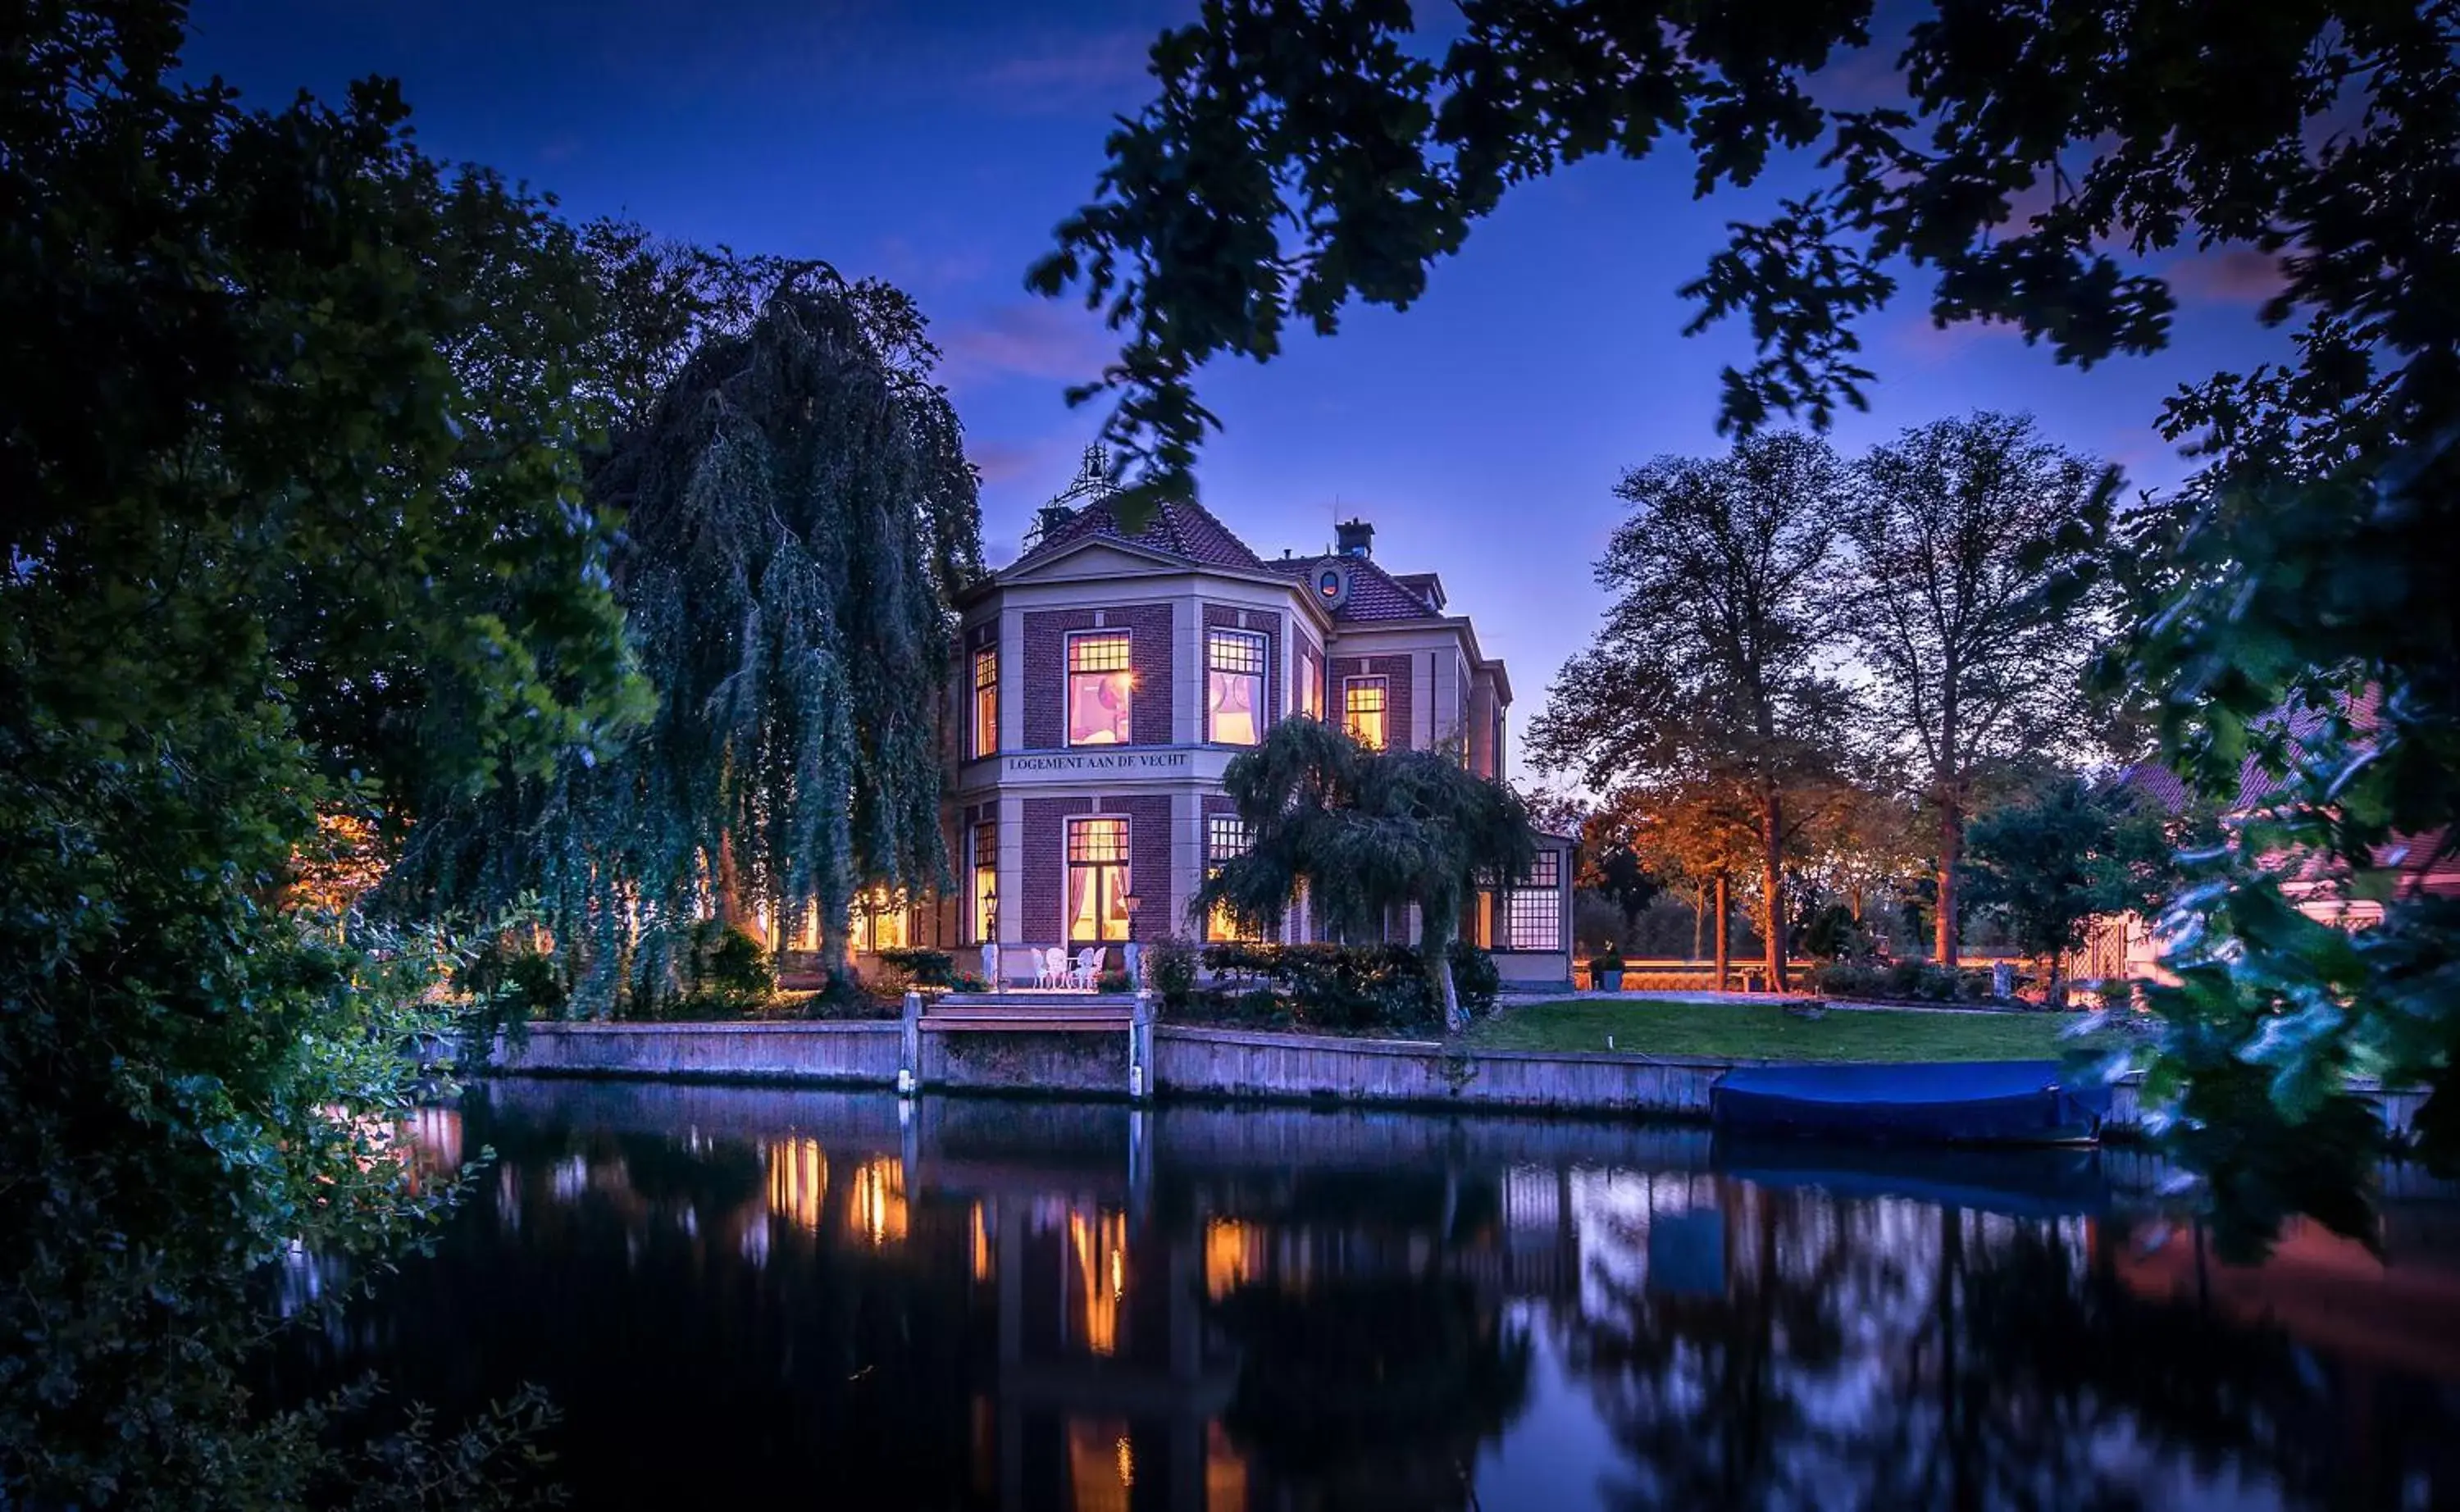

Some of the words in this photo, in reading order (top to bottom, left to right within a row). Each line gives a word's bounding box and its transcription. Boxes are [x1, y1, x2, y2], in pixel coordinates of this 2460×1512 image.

[1009, 757, 1083, 770] LOGEMENT
[1087, 755, 1114, 768] AAN
[1118, 754, 1136, 767] DE
[1140, 753, 1187, 766] VECHT
